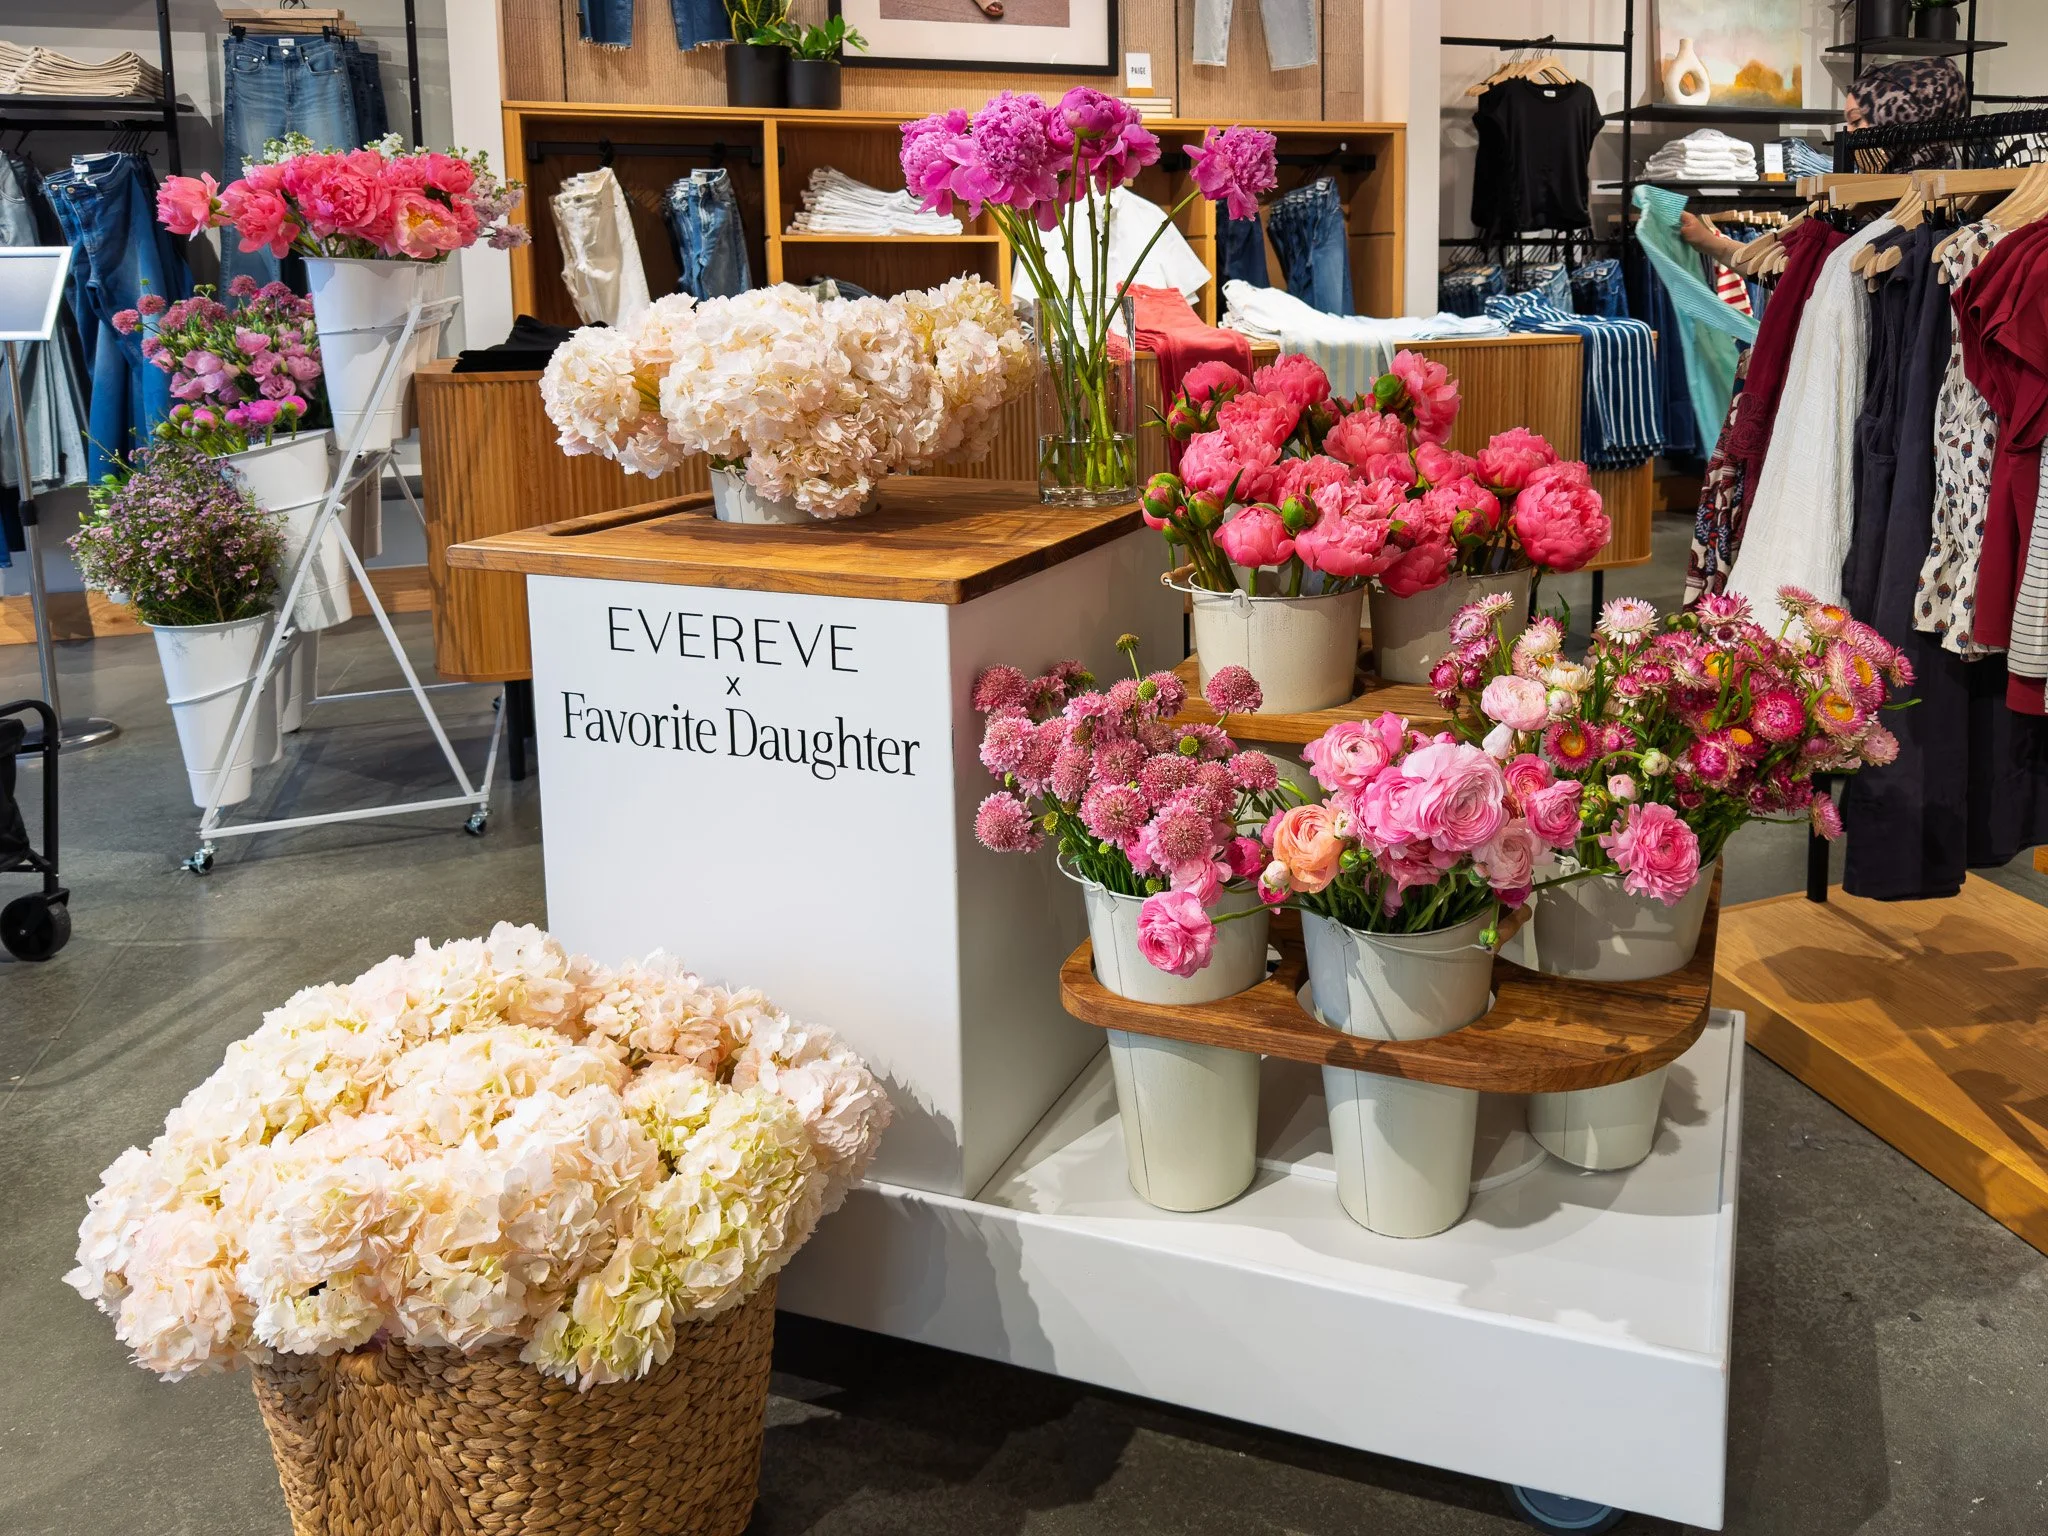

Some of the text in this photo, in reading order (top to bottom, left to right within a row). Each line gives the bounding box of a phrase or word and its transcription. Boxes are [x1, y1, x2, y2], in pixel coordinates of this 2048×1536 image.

[1131, 66, 1147, 75] PAIGE
[607, 606, 859, 673] EVEREVE
[725, 675, 742, 697] x
[560, 691, 921, 781] Favorite Daughter
